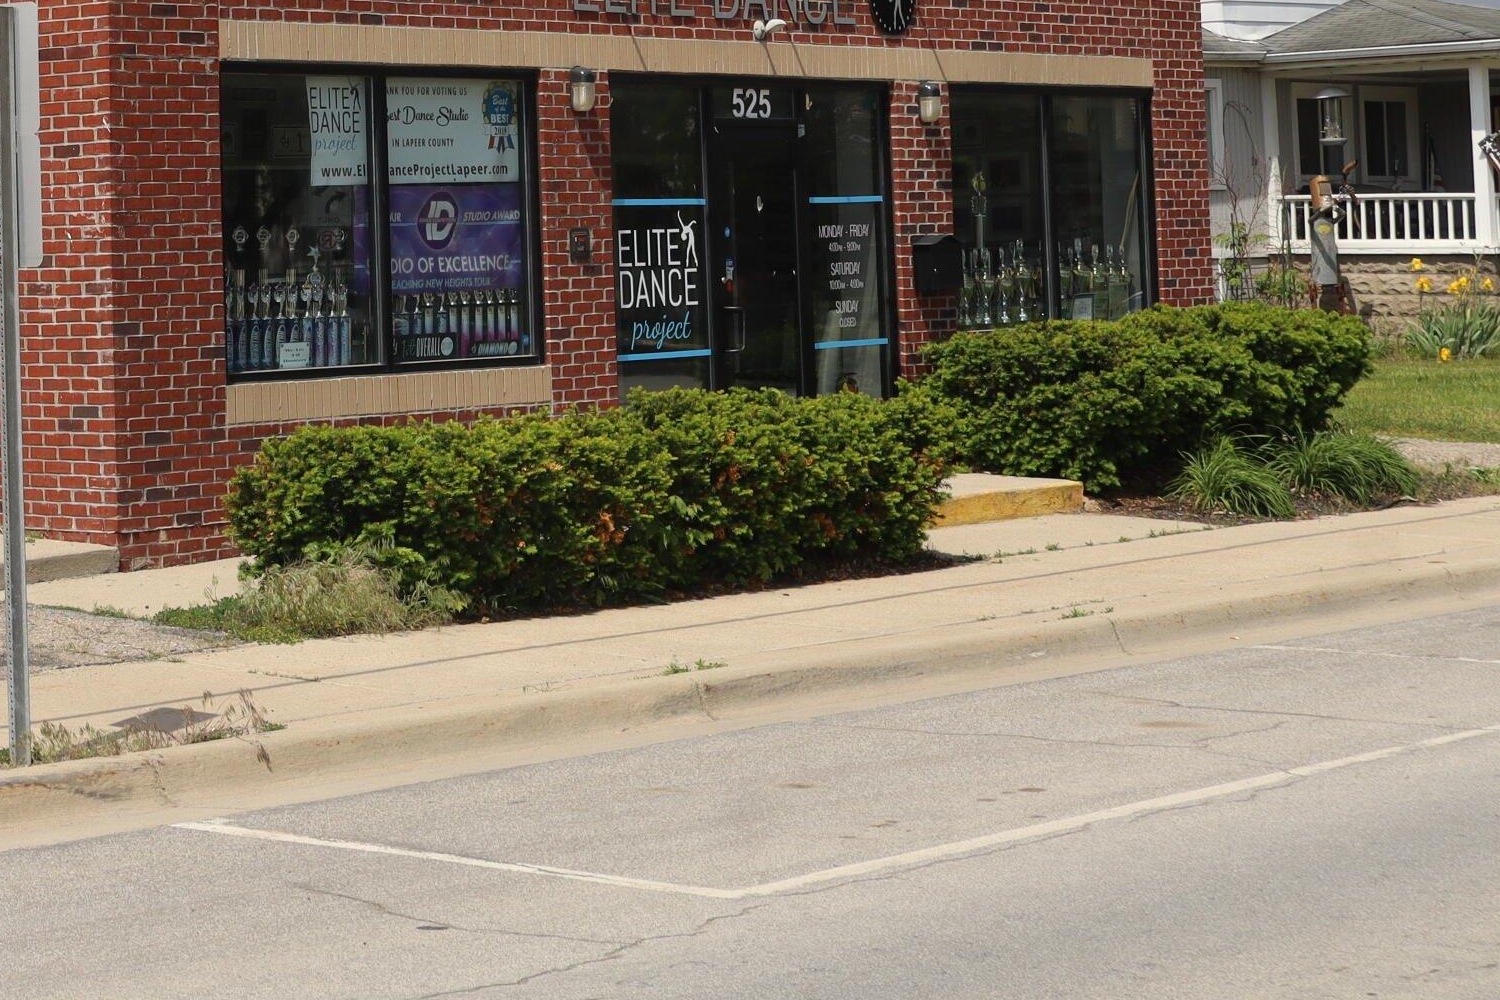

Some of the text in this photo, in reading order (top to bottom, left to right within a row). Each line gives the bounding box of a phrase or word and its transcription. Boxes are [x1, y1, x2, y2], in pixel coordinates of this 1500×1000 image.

[309, 87, 350, 110] ELITE
[401, 87, 415, 95] YOU
[417, 87, 430, 95] FOR
[432, 87, 457, 96] VOTING
[459, 87, 468, 96] US
[732, 88, 771, 118] 525
[311, 111, 360, 133] DANCE
[402, 105, 435, 125] Dance
[436, 106, 469, 127] Studio
[491, 113, 509, 123] BEST
[314, 134, 357, 156] project
[392, 138, 454, 147] IN LAPEER COUNTY
[463, 211, 491, 222] STUDIO
[491, 209, 520, 220] AWARD
[818, 225, 844, 239] MONDAY
[849, 224, 870, 238] FRIDAY
[618, 228, 681, 267] ELITE
[417, 257, 435, 273] OF
[438, 255, 510, 272] EXCELLENCE
[830, 262, 860, 276] SATURDAY
[392, 276, 491, 289] EACHING NEW HEIGHTS TOUR
[619, 268, 699, 309] DANCE
[835, 300, 859, 314] SUNDAY
[631, 311, 691, 350] project
[839, 317, 857, 328] CLOSED
[416, 337, 441, 357] OVERALL
[477, 342, 508, 356] DIAMOND
